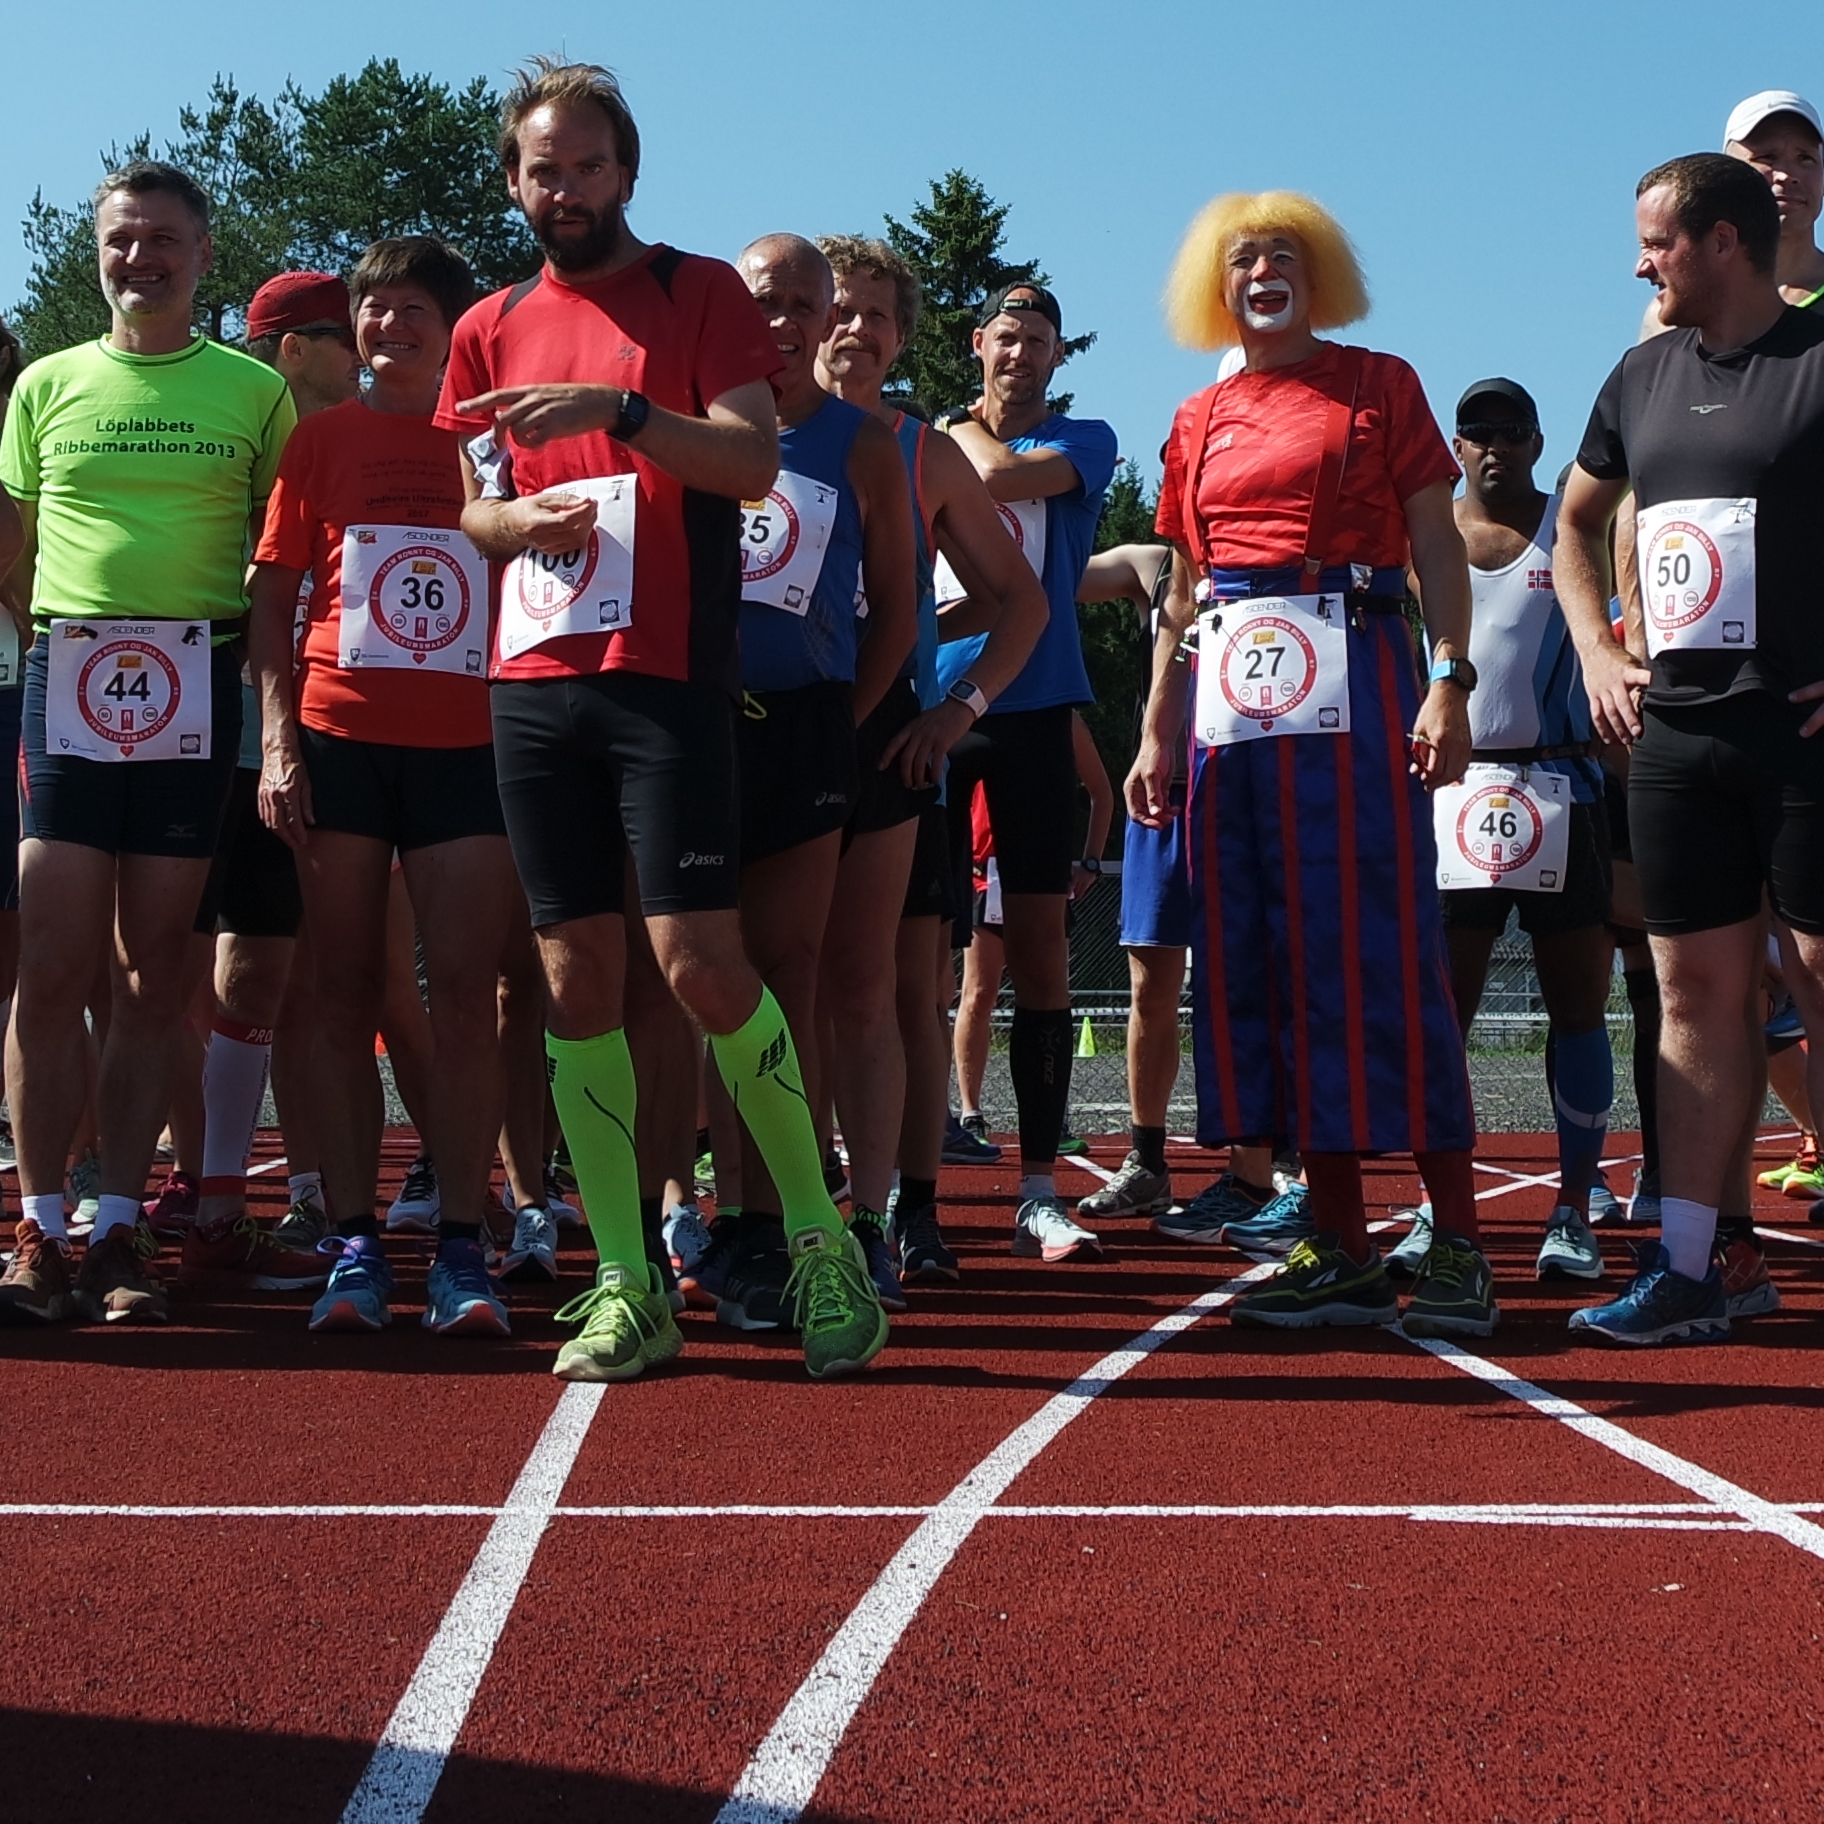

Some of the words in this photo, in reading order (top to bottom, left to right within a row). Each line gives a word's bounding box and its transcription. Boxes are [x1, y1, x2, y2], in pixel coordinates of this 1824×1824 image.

[95, 418, 194, 435] Löplabbets
[54, 439, 190, 455] Ribbemarathon
[194, 441, 235, 458] 2013
[402, 531, 450, 543] ASCENDER
[1685, 524, 1698, 535] JAN
[1697, 532, 1714, 551] BILLY
[380, 558, 396, 576] TEAM
[397, 549, 423, 559] RONNY
[437, 553, 451, 564] JAN
[450, 563, 465, 582] BILLY
[742, 562, 781, 580] MARATON
[1657, 553, 1691, 587] 50
[400, 577, 444, 611] 36
[1242, 602, 1286, 614] ASCENDER
[107, 626, 155, 634] ASCENDER
[380, 623, 459, 649] JUBILEUMSMARATON
[1239, 620, 1261, 634] RONNY
[1276, 621, 1290, 631] JAN
[1290, 627, 1308, 645] BILLY
[86, 652, 102, 670] TEAM
[104, 643, 127, 654] RONNY
[143, 646, 157, 656] JAN
[157, 653, 173, 672] BILLY
[1245, 647, 1286, 680] 27
[104, 671, 151, 702] 44
[1230, 689, 1306, 717] JUBILEUMSMARATON
[88, 715, 168, 742] JUBILEUMSMARATON
[1464, 795, 1477, 811] TEAM
[1522, 797, 1536, 814] BILLY
[1479, 811, 1517, 838] 46
[695, 855, 725, 865] asics
[1464, 851, 1532, 870] JUBILEUMSMARATON
